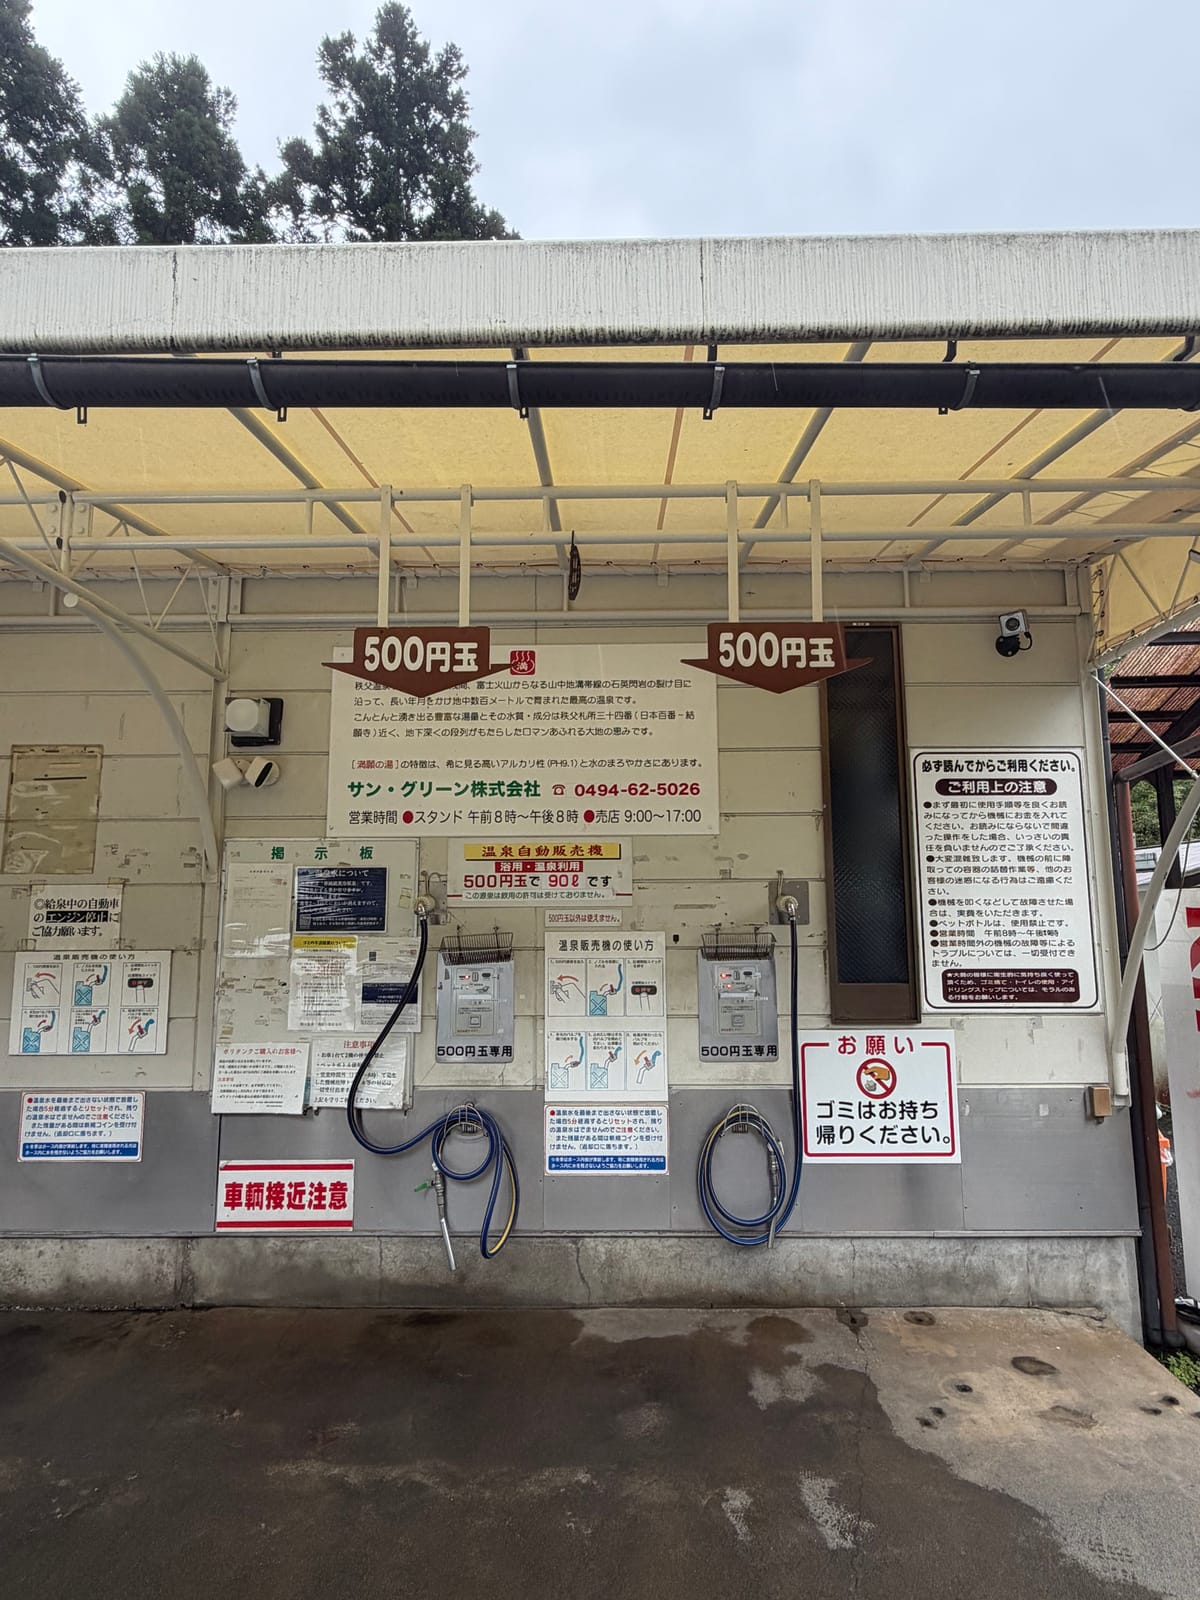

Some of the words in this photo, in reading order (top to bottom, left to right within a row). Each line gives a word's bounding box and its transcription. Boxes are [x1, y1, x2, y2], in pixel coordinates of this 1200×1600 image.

[364, 636, 479, 673] 500円玉
[719, 632, 836, 669] 500円玉
[921, 759, 1076, 773] 必ず読んでからご利用ください。
[347, 780, 541, 798] サン・グリーン株式会社
[574, 783, 701, 797] 0494-62-5026
[948, 780, 1048, 794] ご利用上の注意
[349, 810, 398, 825] 営業時間
[414, 810, 463, 824] スタンド
[595, 809, 620, 824] 売店
[482, 845, 604, 858] 温泉自動販売機
[500, 861, 581, 872] 浴用・温泉利用
[464, 875, 541, 888] 500円玉で
[587, 875, 612, 888] です
[927, 888, 951, 896] さい。
[939, 929, 976, 938] 営業時間
[558, 939, 655, 952] 温泉販売機の使い方
[437, 1045, 512, 1057] 500円玉専用
[701, 1045, 777, 1057] 500円玉専用
[838, 1035, 915, 1055] お願い
[816, 1101, 938, 1120] ゴミはお持ち
[815, 1125, 951, 1145] 帰りください。
[223, 1181, 349, 1211] 車輌接近注意
